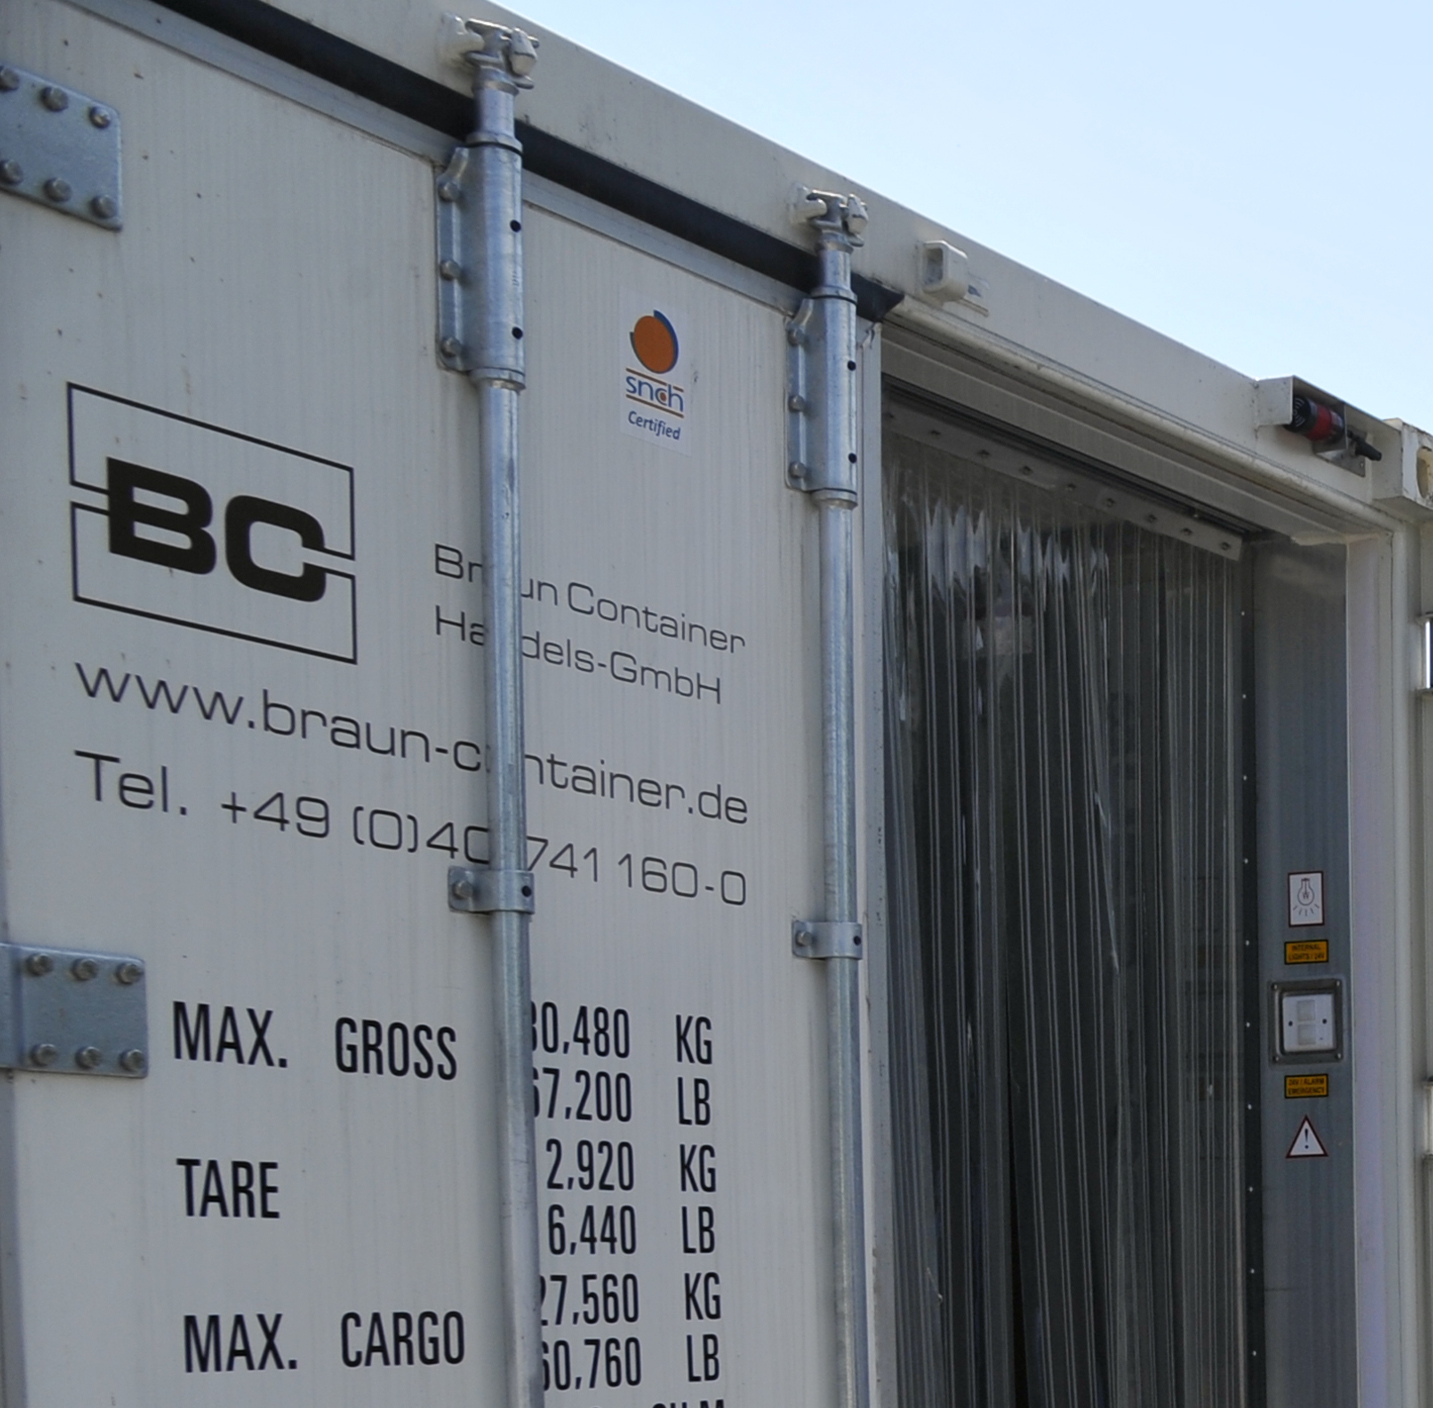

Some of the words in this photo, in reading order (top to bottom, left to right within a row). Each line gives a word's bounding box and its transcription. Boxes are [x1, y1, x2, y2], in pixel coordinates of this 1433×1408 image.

[626, 376, 684, 412] snch
[628, 411, 681, 440] Certified
[107, 457, 326, 602] BC
[434, 543, 558, 606] Brun
[567, 582, 745, 654] Container
[435, 605, 721, 704] Hadels-GmbH
[75, 662, 748, 825] www.braun-cntainer.de
[74, 749, 187, 816] Tel.
[221, 791, 329, 838] +49
[526, 835, 598, 882] 741
[617, 853, 746, 906] 160-0
[1291, 944, 1321, 952] INTERNAL
[173, 1000, 288, 1068] MAX.
[334, 1017, 458, 1081] GROSS
[676, 1014, 713, 1065] KG
[677, 1076, 711, 1125] LB
[176, 1158, 281, 1219] TARE
[546, 1138, 634, 1191] 2,920
[679, 1143, 716, 1192] KG
[548, 1204, 636, 1255] 6,440
[681, 1206, 715, 1254] LB
[183, 1313, 298, 1373] MAX.
[340, 1310, 465, 1368] CARGO
[684, 1272, 721, 1320] KG
[686, 1334, 720, 1382] LB
